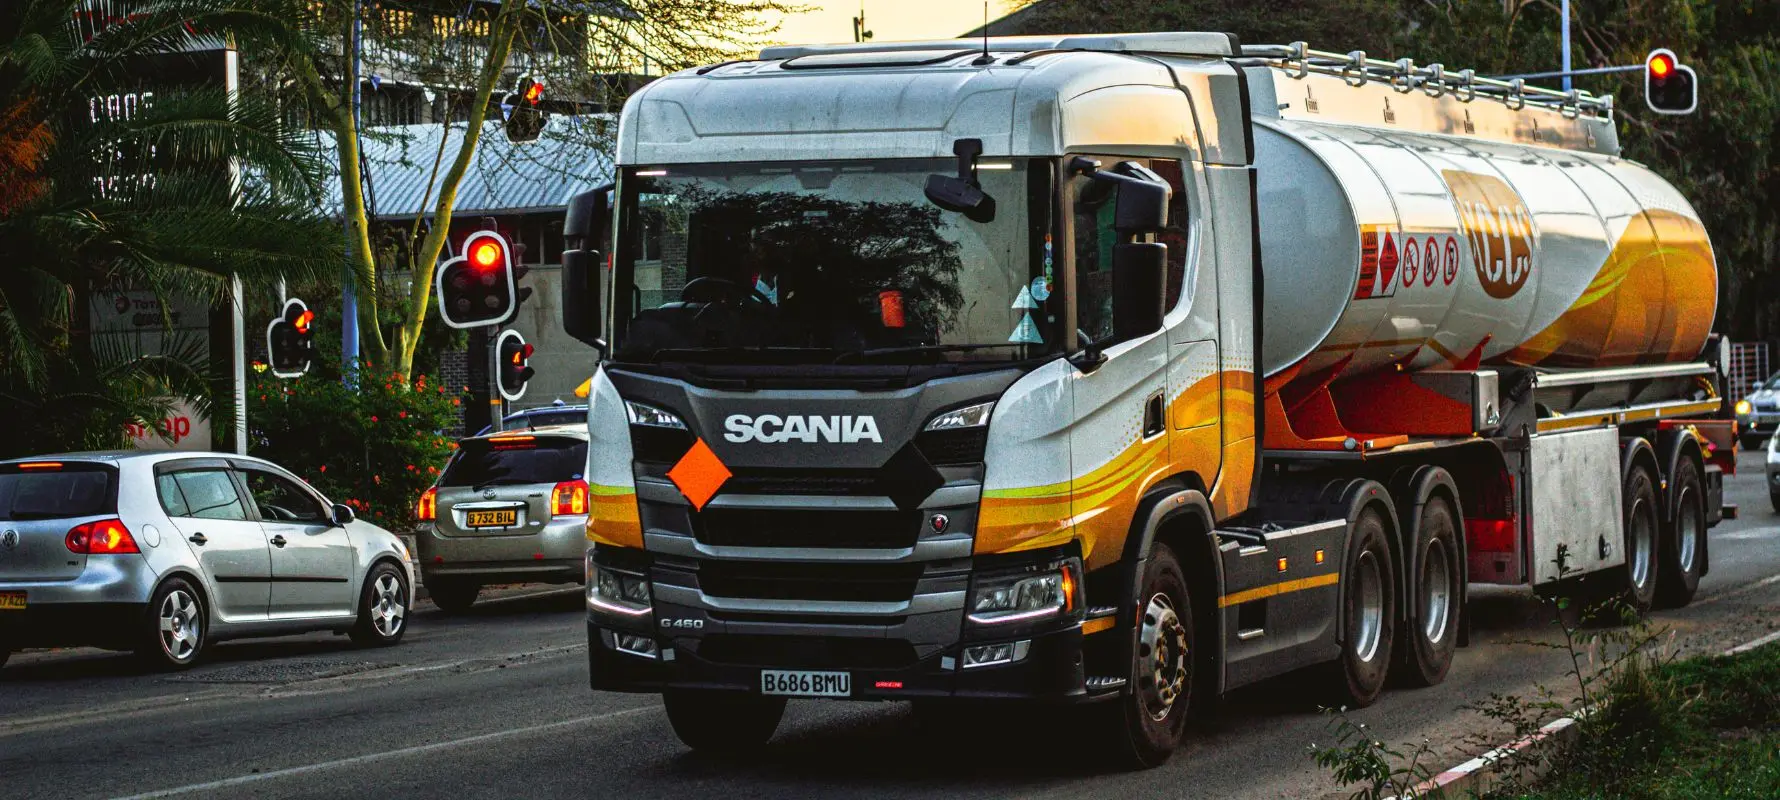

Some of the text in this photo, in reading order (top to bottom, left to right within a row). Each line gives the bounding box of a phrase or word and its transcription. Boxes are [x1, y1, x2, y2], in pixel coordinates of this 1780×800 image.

[724, 414, 883, 444] SCANIA
[468, 511, 514, 525] B 732 BIL
[660, 618, 704, 629] G 460
